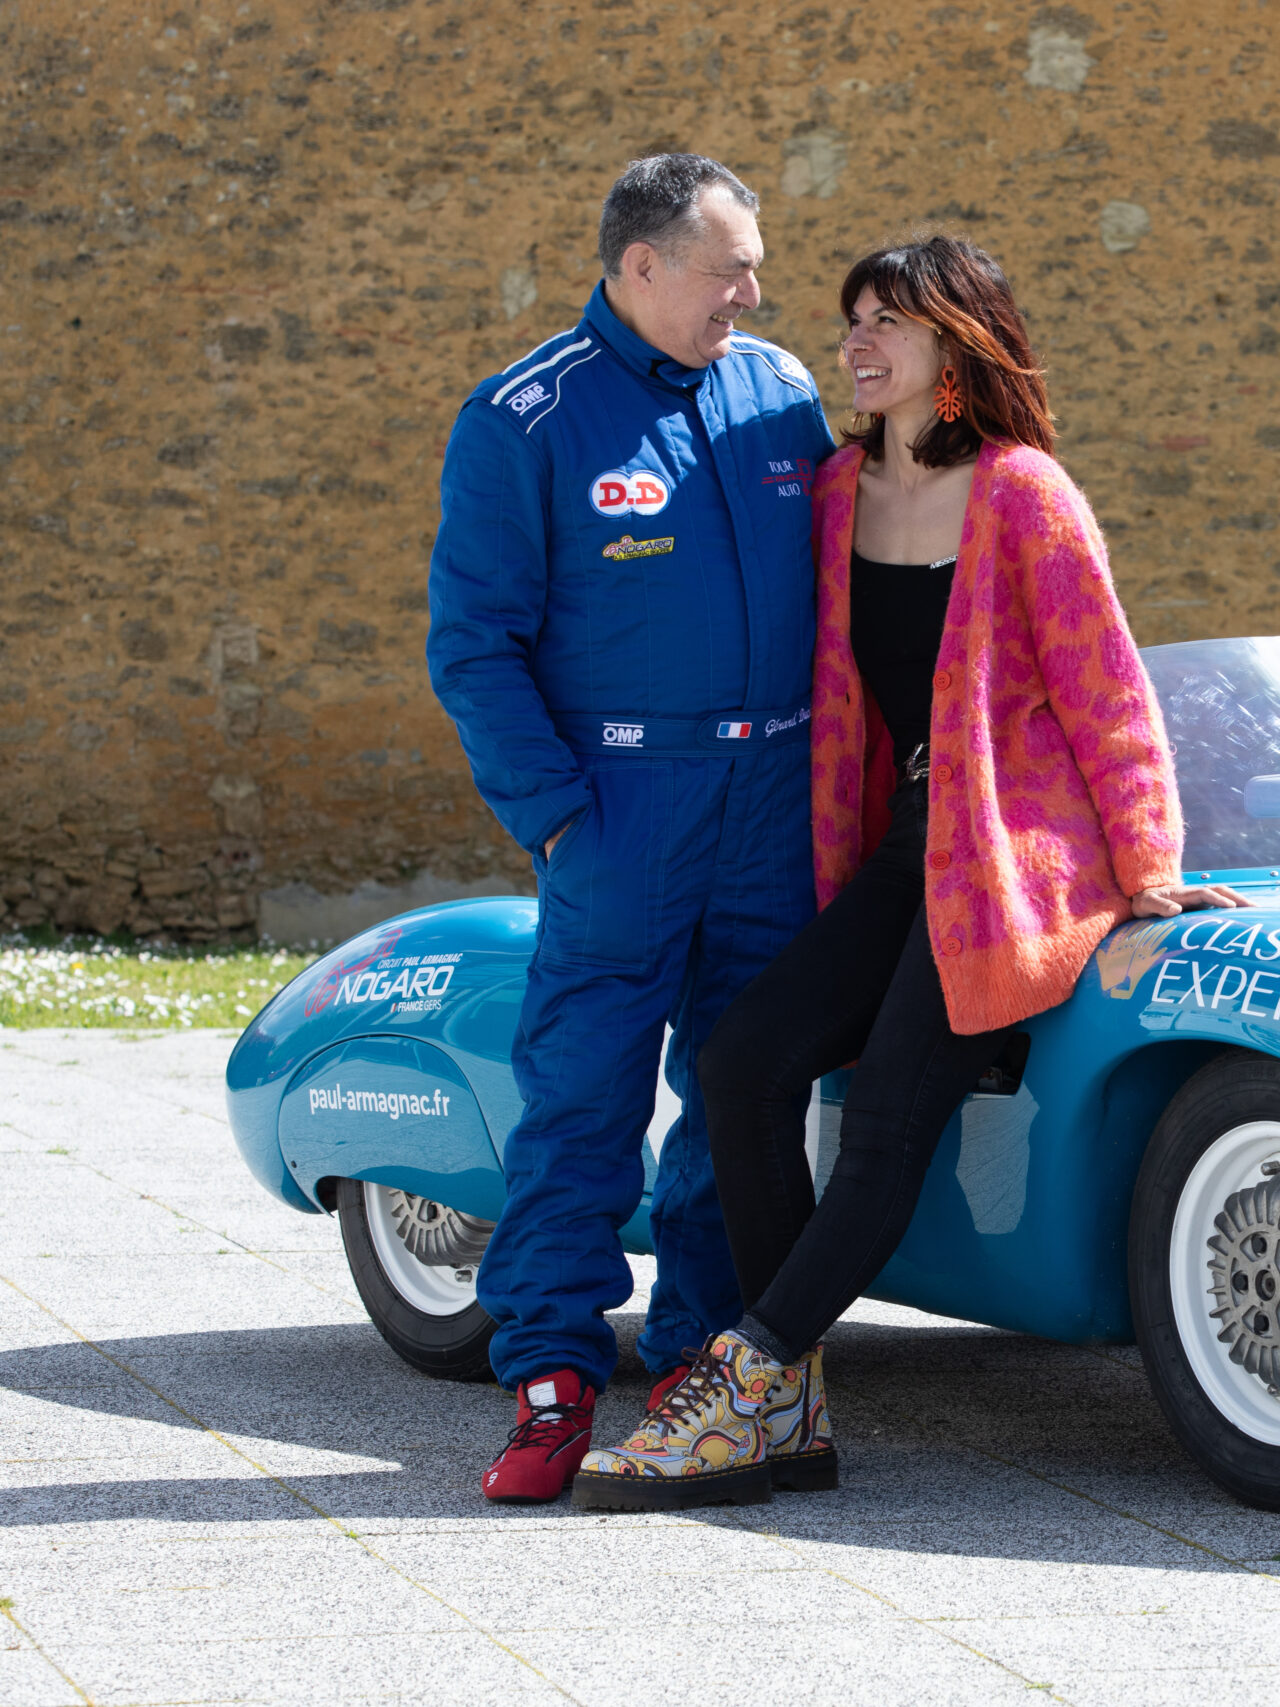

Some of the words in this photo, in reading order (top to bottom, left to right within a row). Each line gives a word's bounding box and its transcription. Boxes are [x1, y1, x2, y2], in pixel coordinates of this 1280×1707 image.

[510, 384, 545, 412] OMP
[767, 460, 794, 473] TOUR
[778, 483, 801, 497] AUTO
[616, 538, 673, 556] NOGARO
[603, 726, 644, 744] OMP
[377, 957, 403, 970] CIRCUIT
[401, 955, 421, 968] PAUL
[420, 952, 464, 966] ARMAGNAC
[333, 965, 456, 1006] NOGARO
[397, 1000, 424, 1013] FRANCE
[423, 999, 443, 1011] GERS
[309, 1083, 450, 1120] paul-armagnac.fr
